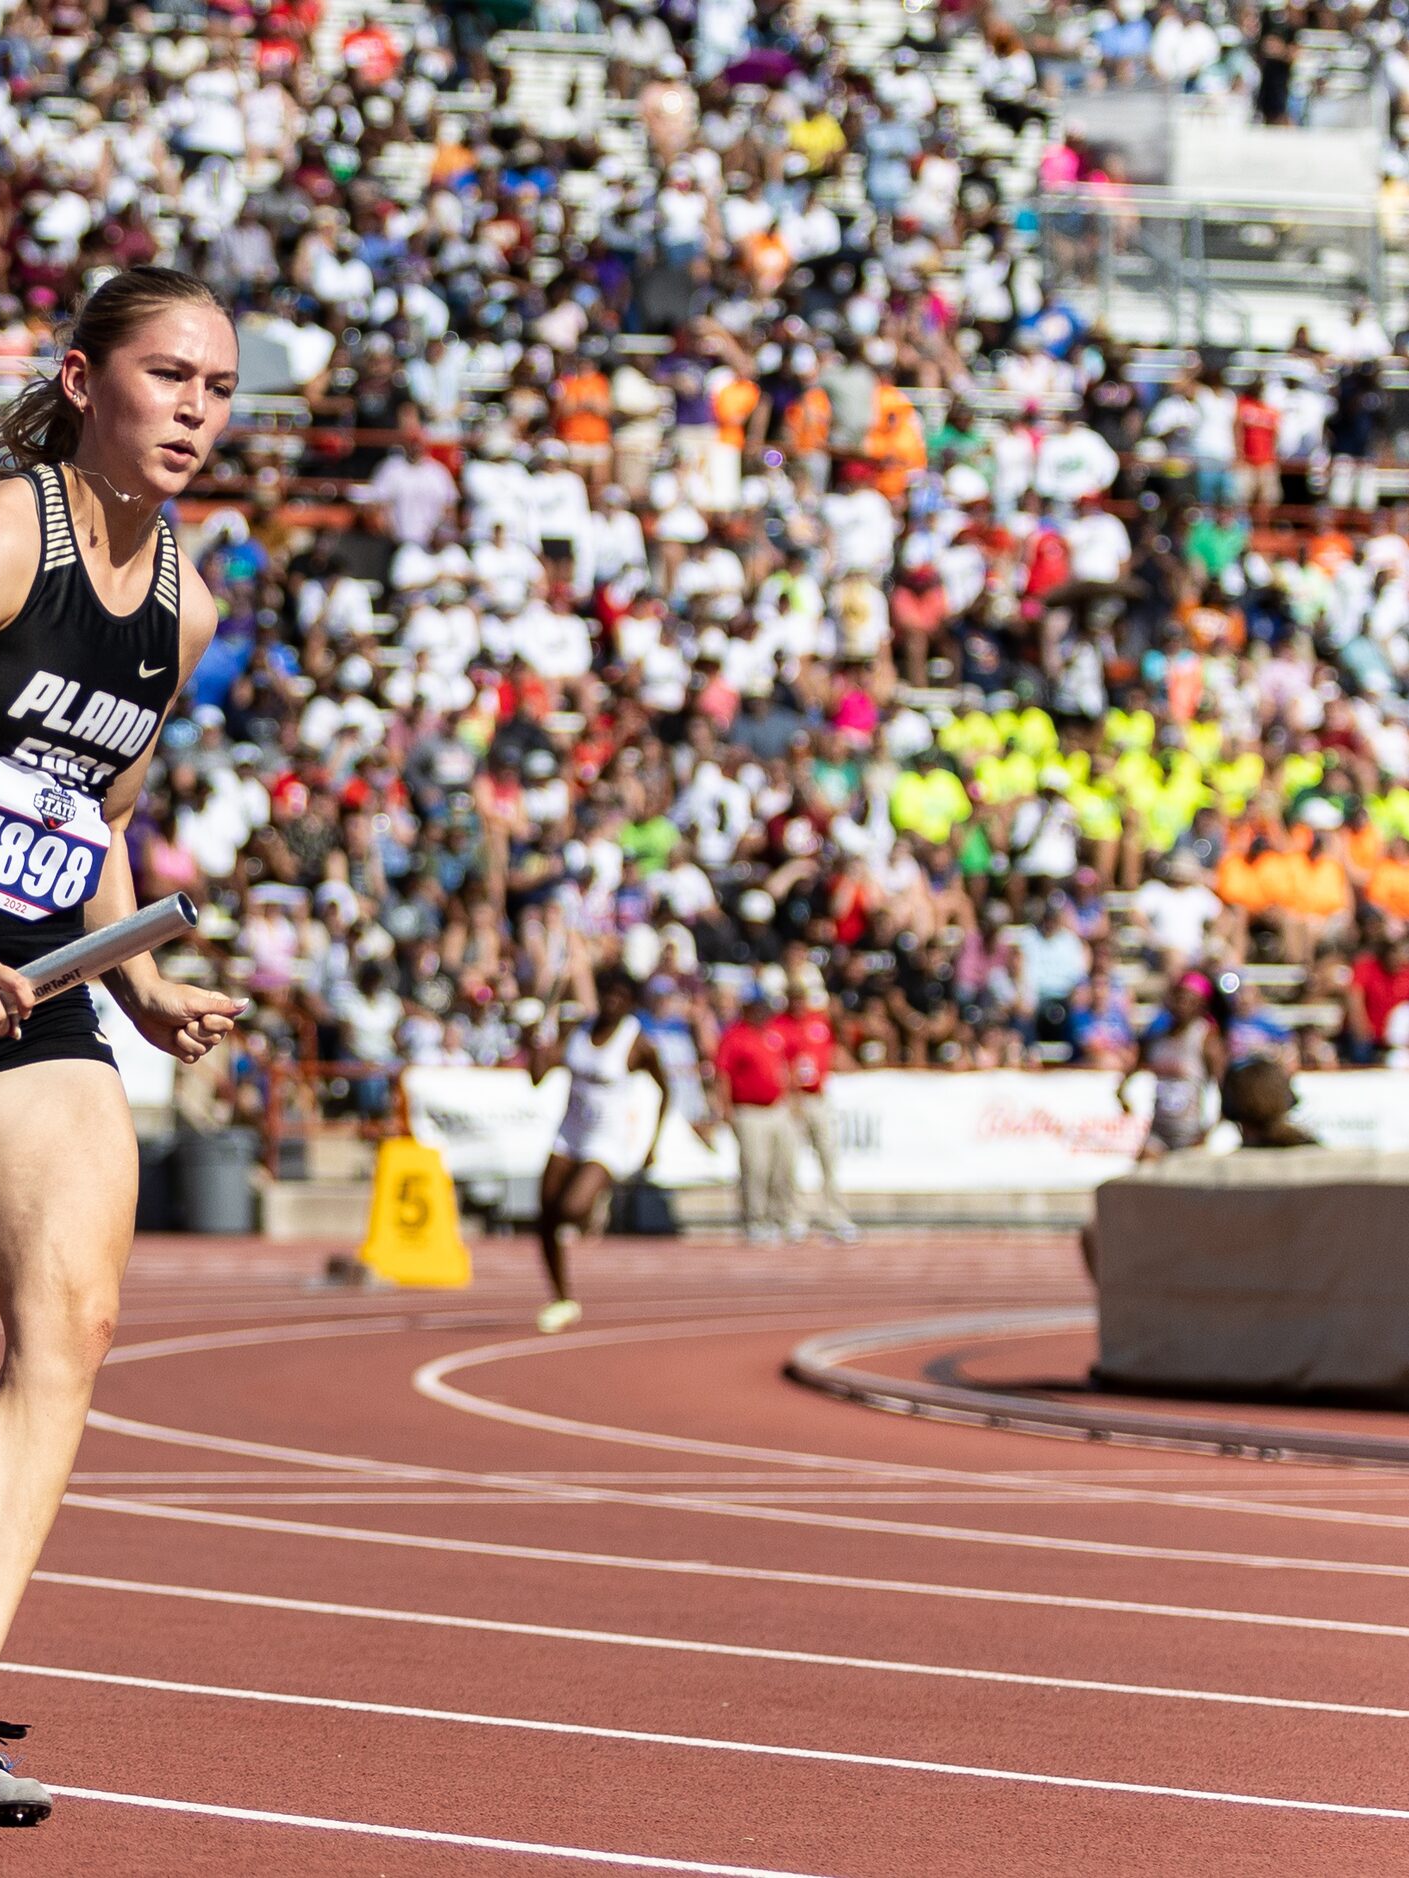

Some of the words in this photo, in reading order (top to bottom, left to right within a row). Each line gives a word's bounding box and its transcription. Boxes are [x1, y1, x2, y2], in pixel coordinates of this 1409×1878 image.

[7, 670, 158, 758] PLANO
[34, 794, 77, 820] STATE
[3, 897, 28, 914] 2022
[397, 1174, 430, 1230] 5
